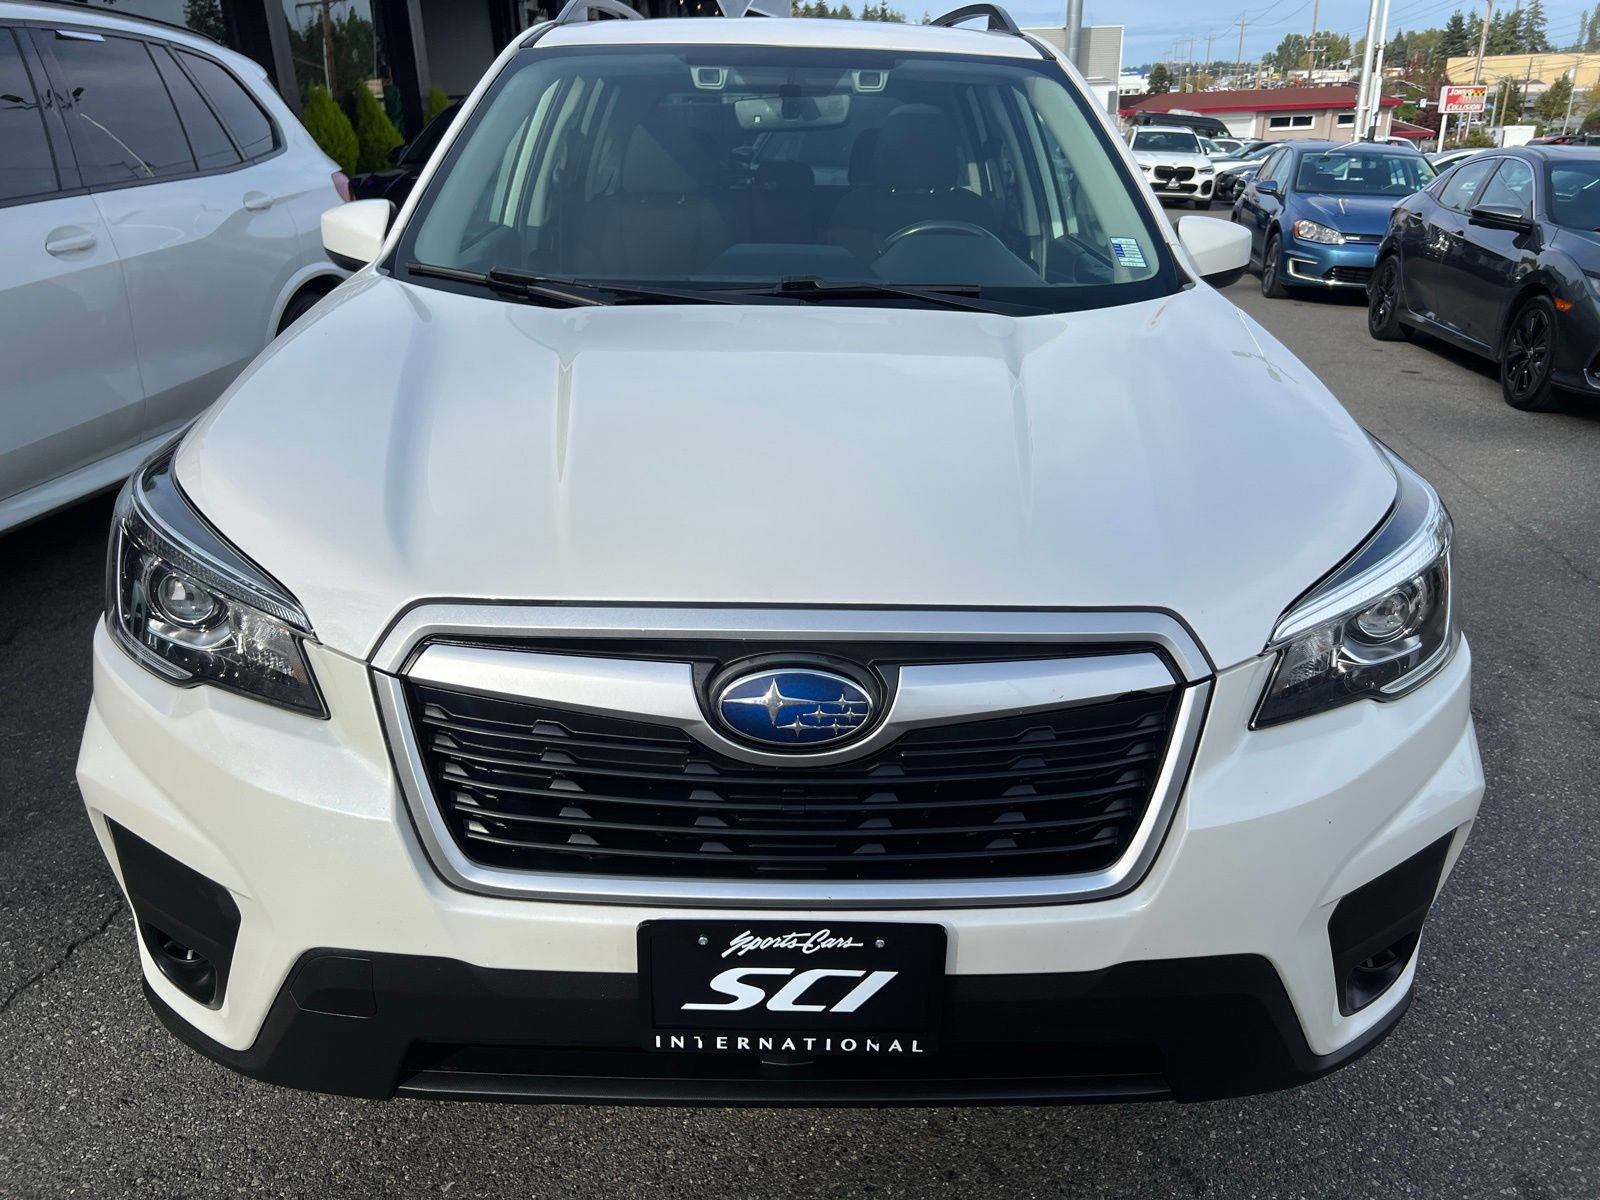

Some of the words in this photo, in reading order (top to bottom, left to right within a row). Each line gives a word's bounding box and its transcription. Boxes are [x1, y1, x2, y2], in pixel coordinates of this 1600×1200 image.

[720, 929, 811, 958] Sports
[801, 928, 864, 954] Cars
[681, 967, 898, 1013] SCI
[655, 1035, 923, 1053] INTERNATIONAL
